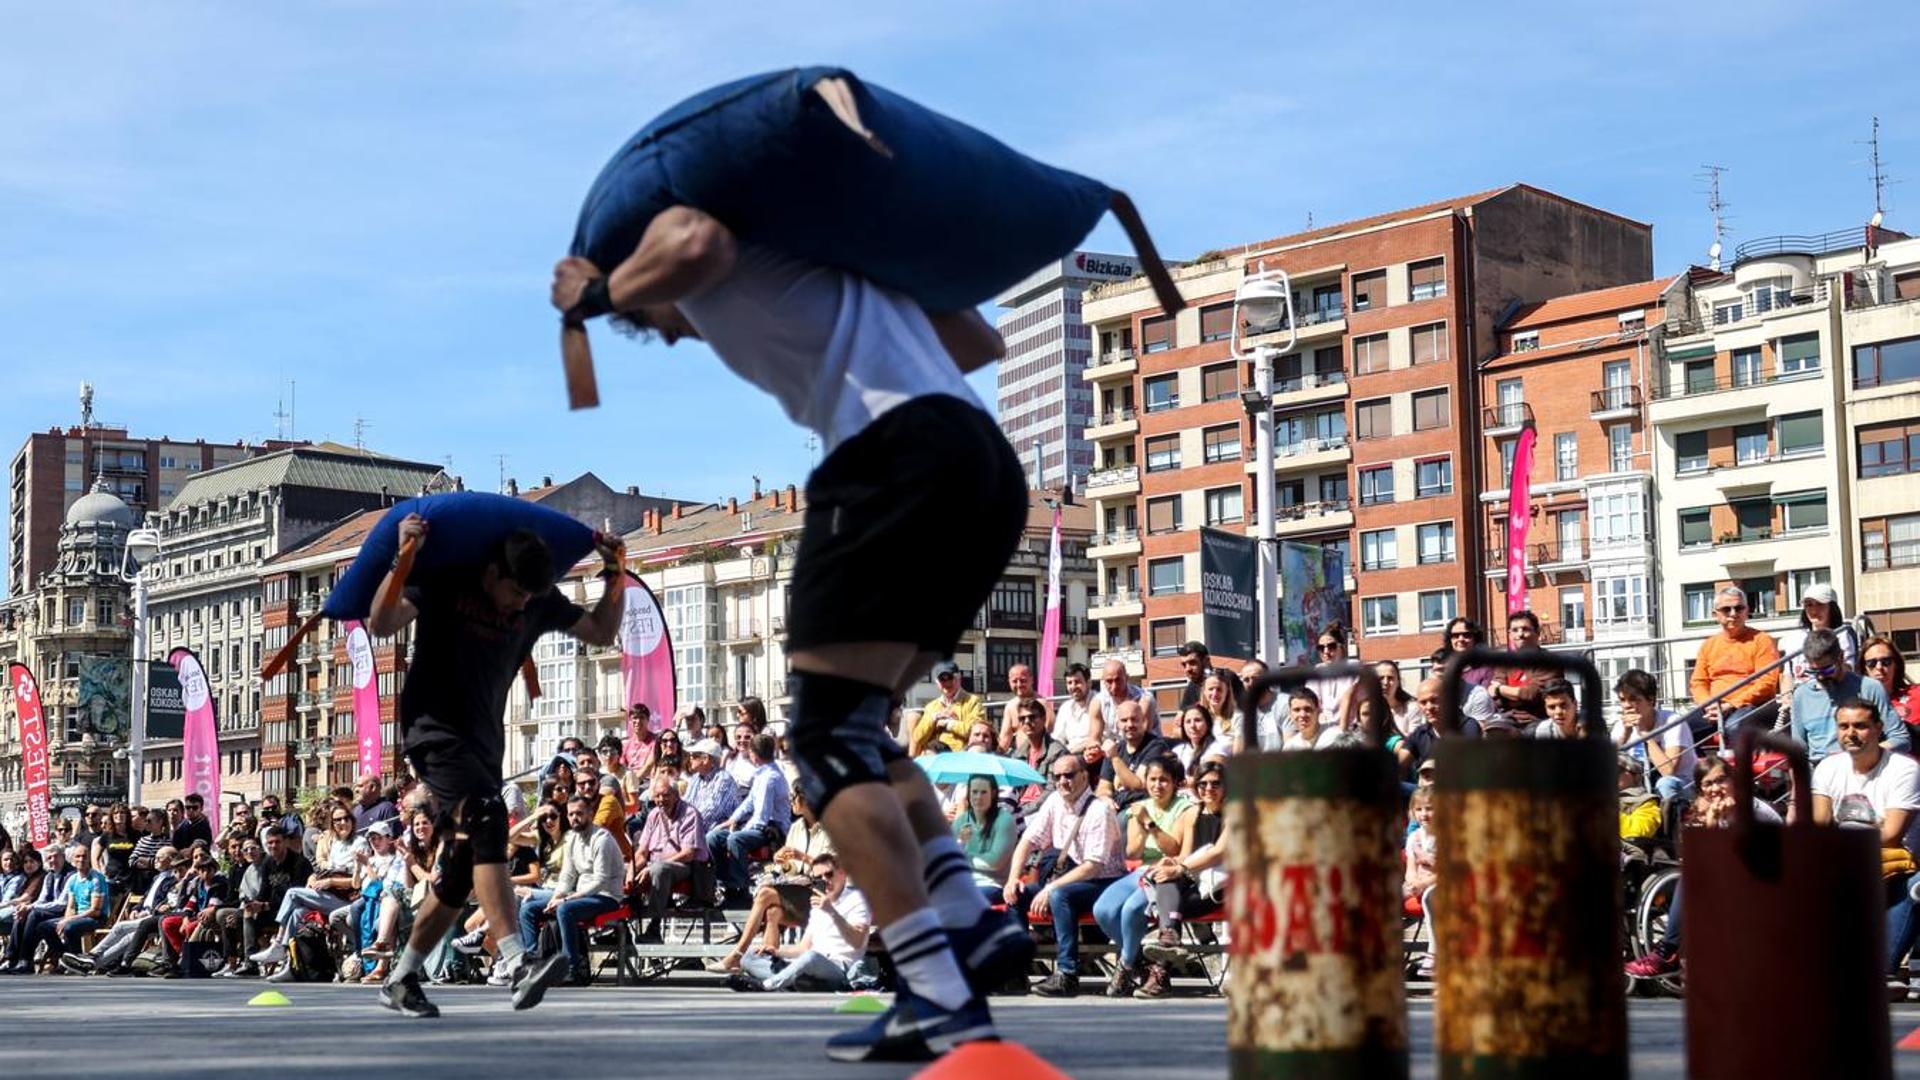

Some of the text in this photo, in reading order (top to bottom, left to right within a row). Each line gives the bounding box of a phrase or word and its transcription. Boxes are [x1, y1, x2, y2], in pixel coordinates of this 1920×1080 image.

[1086, 259, 1133, 277] Bizkaia
[1203, 571, 1234, 593] OSKAR
[1203, 589, 1253, 614] KOKOSCHKA
[150, 687, 179, 699] OSKAR
[150, 697, 185, 709] KOKOSC
